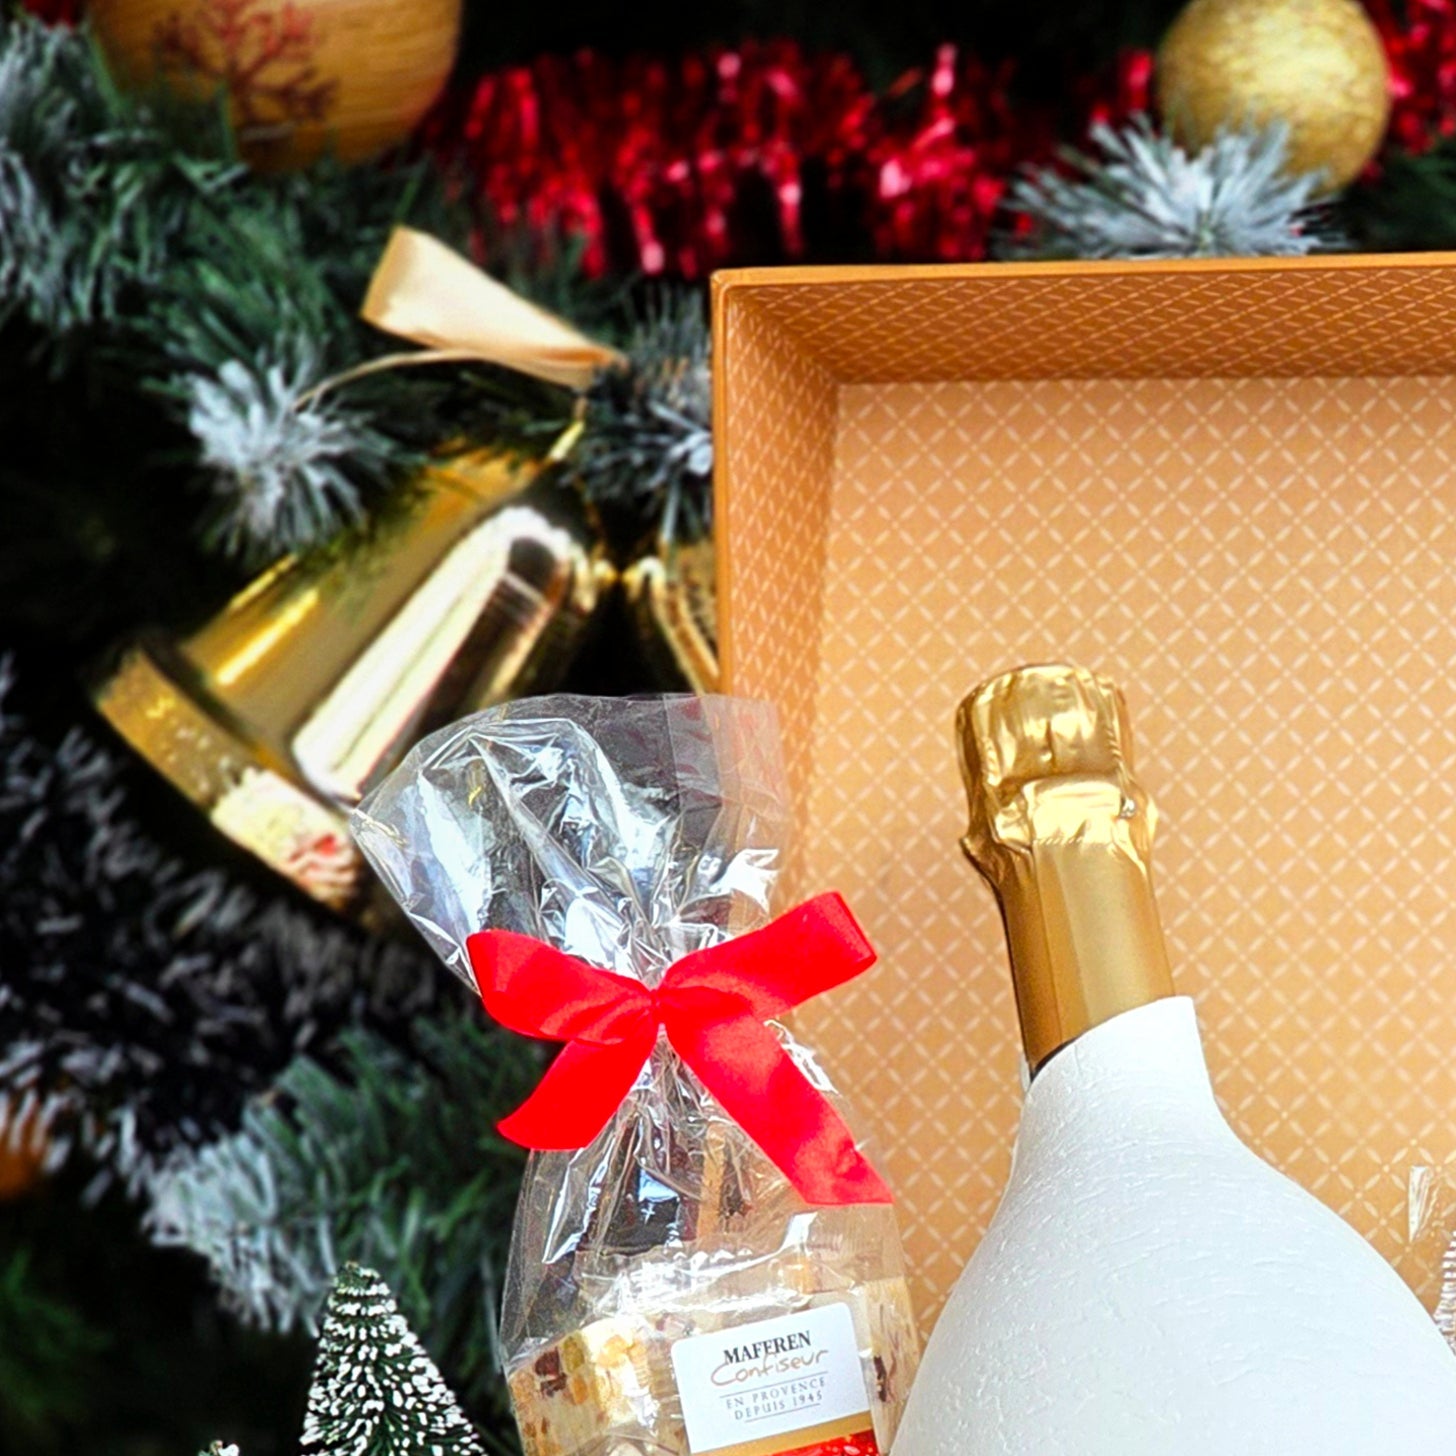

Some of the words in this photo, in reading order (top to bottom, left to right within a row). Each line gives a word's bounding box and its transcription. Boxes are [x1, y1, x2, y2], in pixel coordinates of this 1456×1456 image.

[724, 1331, 812, 1365] MAFFREN
[711, 1349, 829, 1387] Confiseur
[726, 1398, 745, 1410] EN
[751, 1377, 827, 1404] PROVENCE
[734, 1400, 787, 1421] DEPUIS
[792, 1390, 824, 1406] 1945
